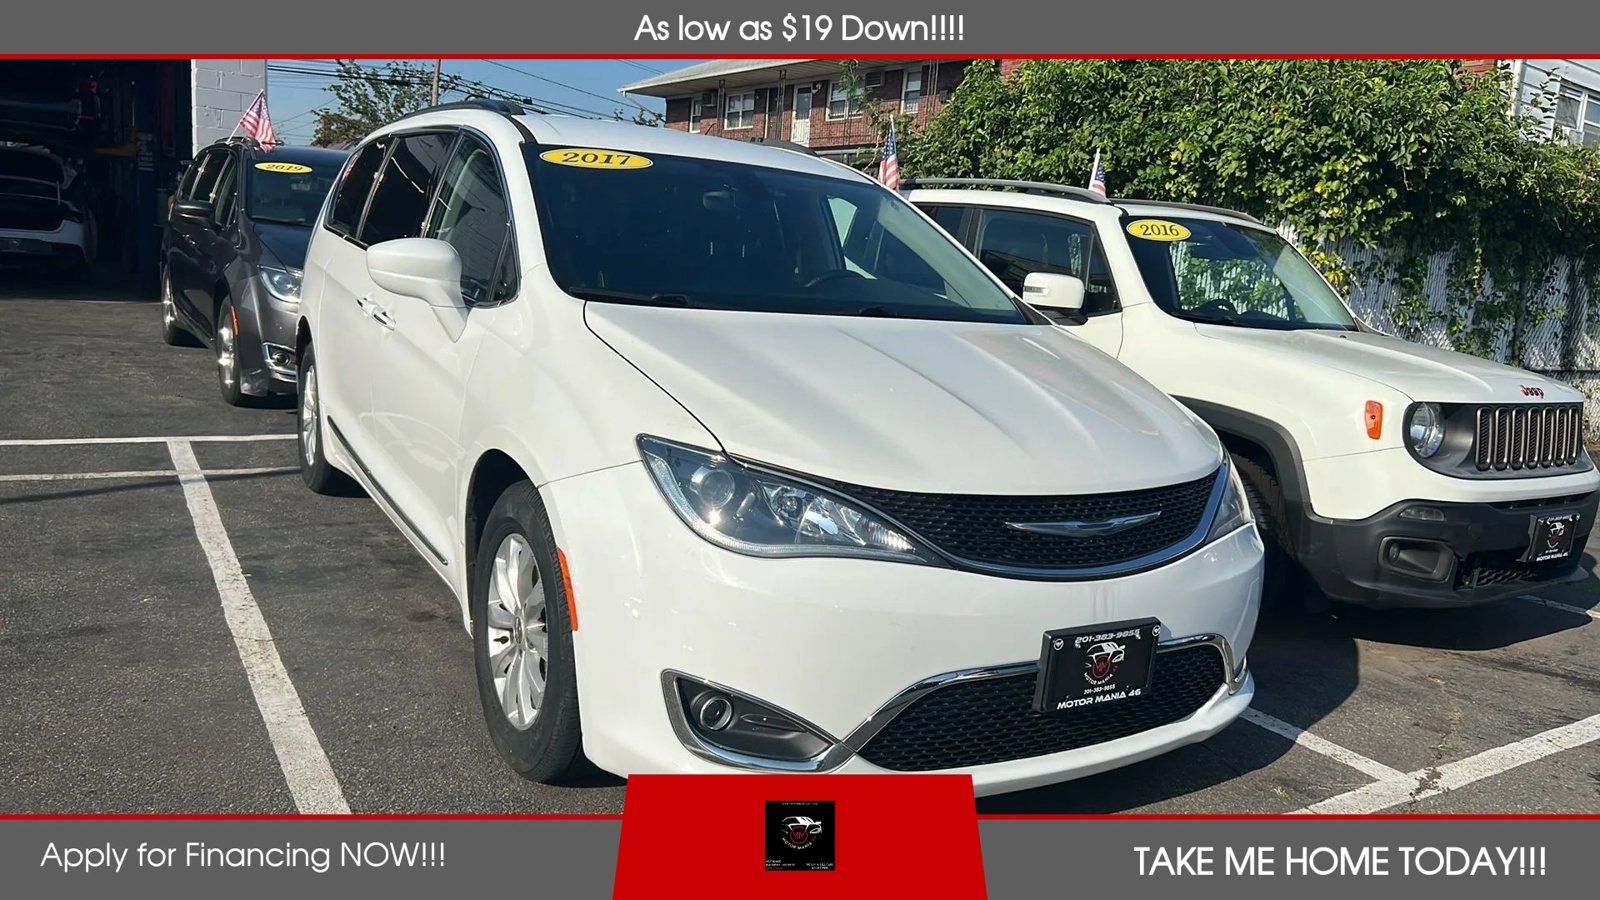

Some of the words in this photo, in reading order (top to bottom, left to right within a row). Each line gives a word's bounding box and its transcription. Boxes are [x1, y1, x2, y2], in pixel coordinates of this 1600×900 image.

[562, 151, 630, 166] 2017
[1140, 223, 1180, 237] 2016
[1057, 698, 1094, 710] MOTOR
[1095, 691, 1127, 703] MANIA
[1128, 688, 1142, 697] 46
